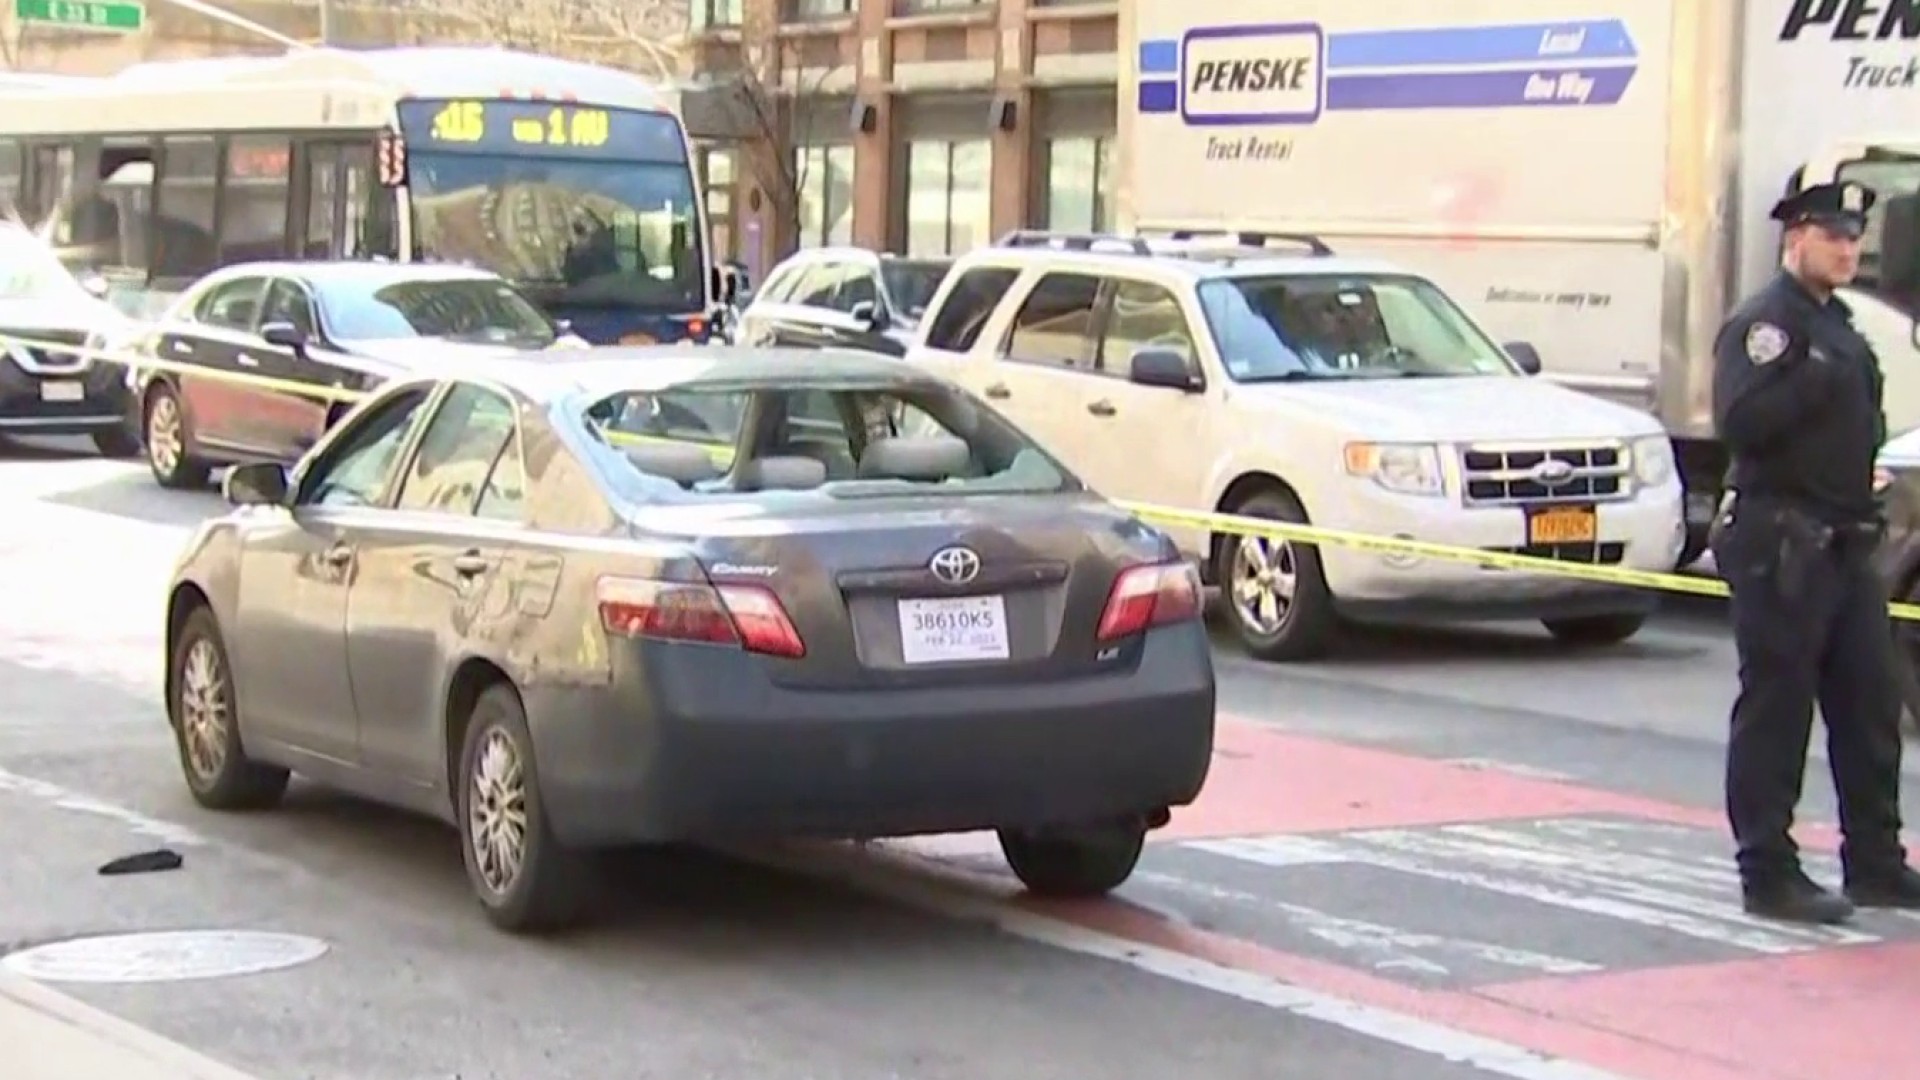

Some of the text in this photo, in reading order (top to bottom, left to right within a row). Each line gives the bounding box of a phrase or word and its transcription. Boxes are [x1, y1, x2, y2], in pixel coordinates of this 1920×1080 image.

[1192, 57, 1311, 94] PENSKE
[1843, 56, 1920, 88] Truck
[1206, 136, 1293, 160] Truck Rental
